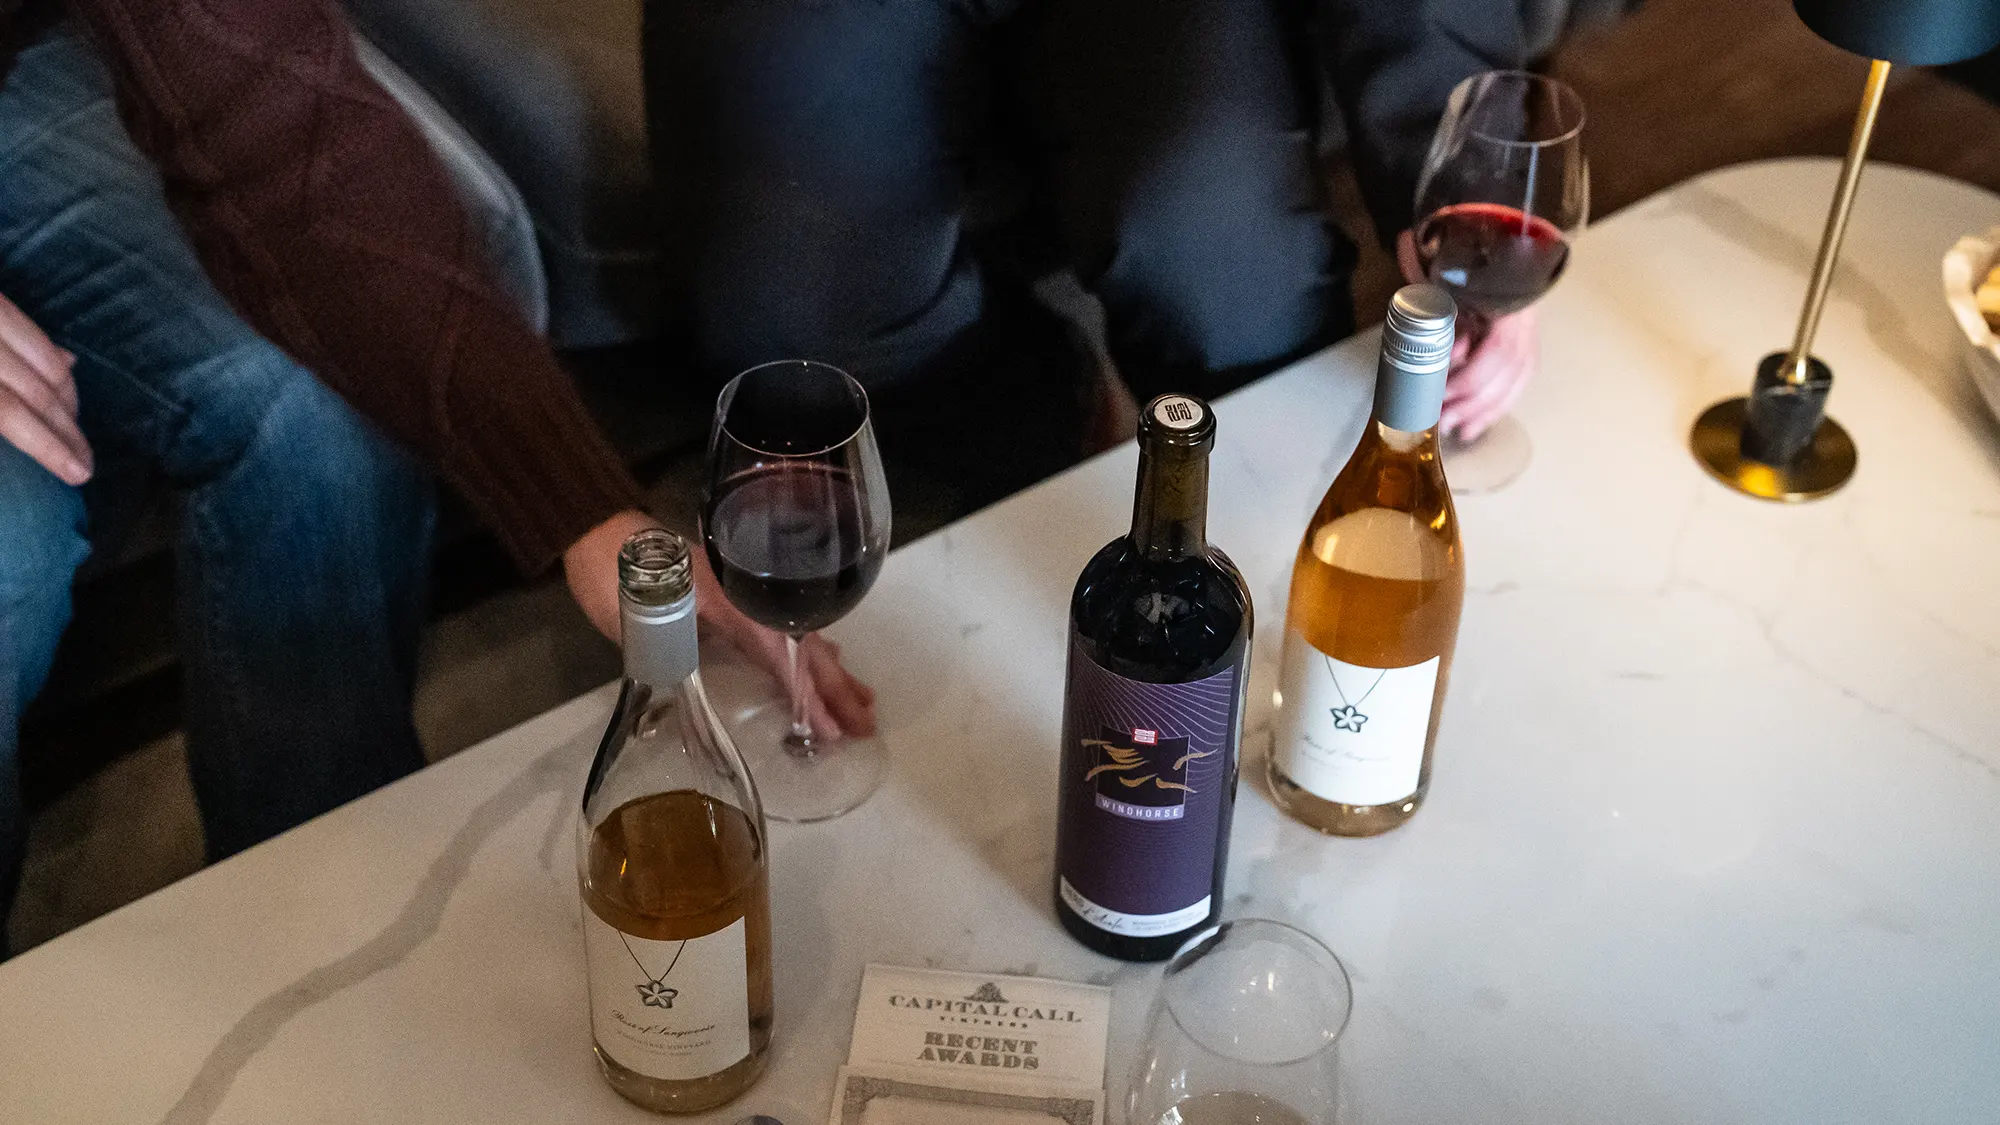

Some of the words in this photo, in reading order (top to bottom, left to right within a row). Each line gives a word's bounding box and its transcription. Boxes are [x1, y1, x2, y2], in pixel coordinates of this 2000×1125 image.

[1101, 799, 1180, 818] WINDHORSE
[888, 994, 1008, 1018] CAPITAL
[1012, 1006, 1082, 1023] CALL
[924, 1031, 1038, 1054] RECENT
[917, 1047, 1040, 1070] AWARDS
